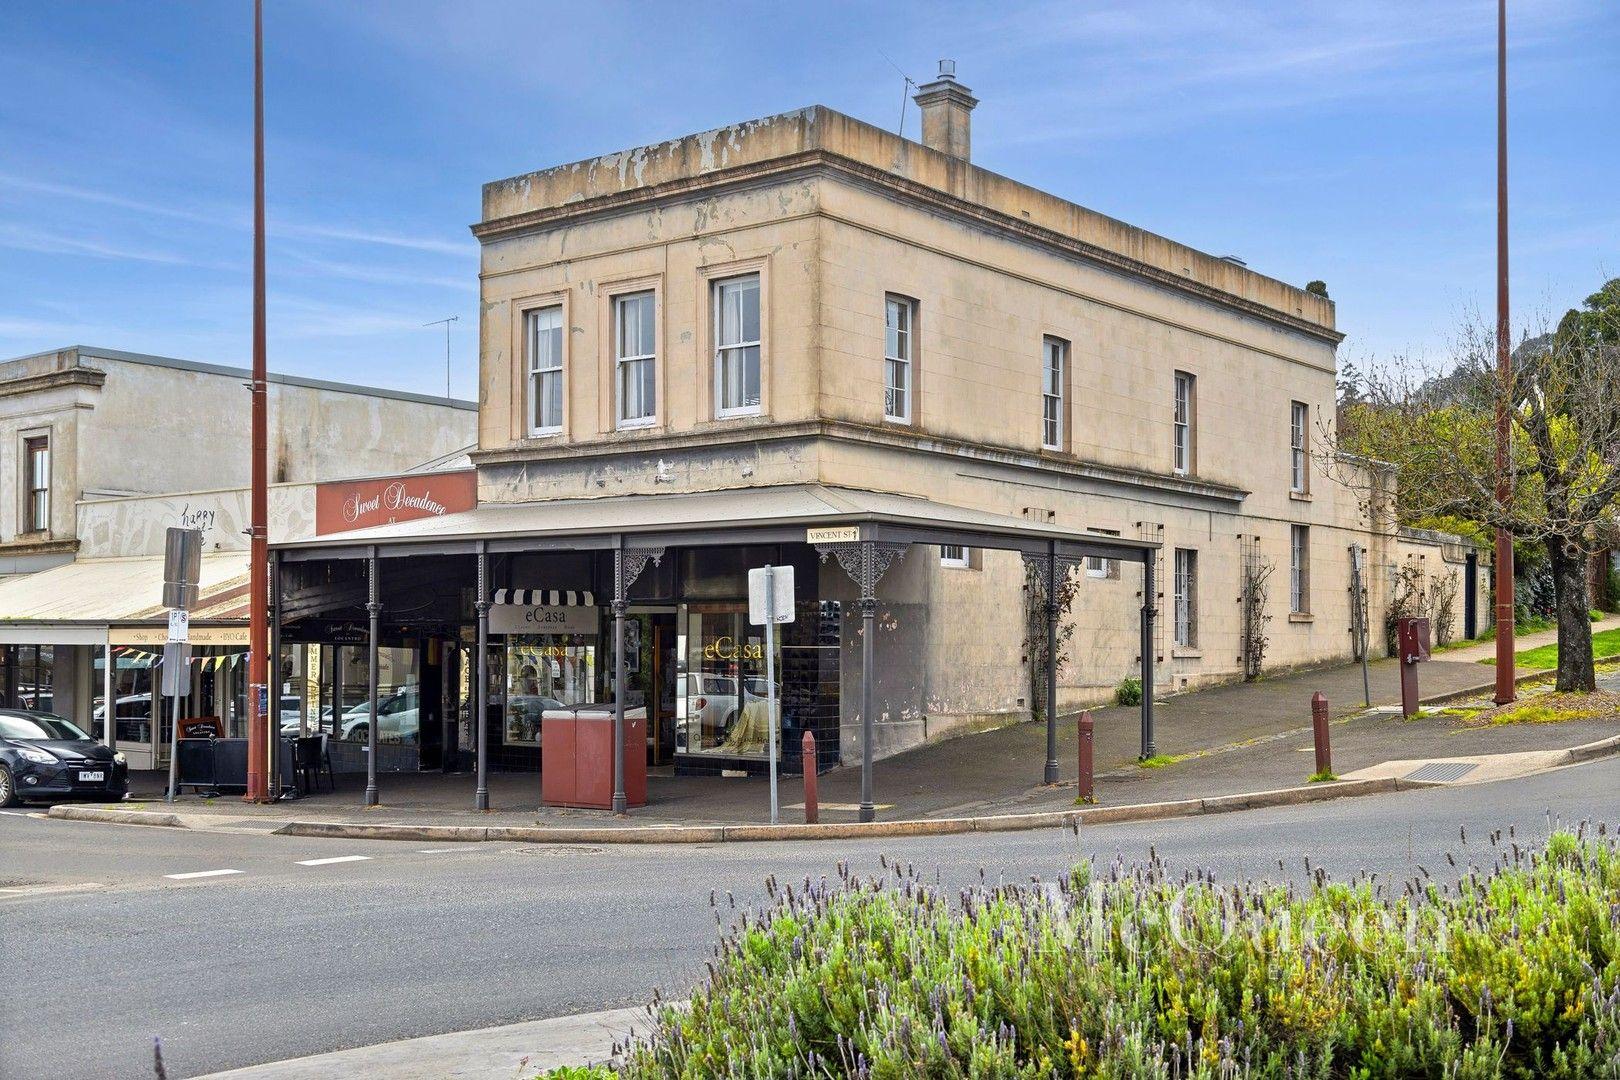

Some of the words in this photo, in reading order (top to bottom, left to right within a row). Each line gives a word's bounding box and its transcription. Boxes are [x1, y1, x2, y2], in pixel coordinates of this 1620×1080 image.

[343, 493, 380, 523] Sweet
[384, 482, 446, 516] Decadence
[182, 503, 215, 526] happy
[810, 531, 842, 540] VINCENT
[525, 606, 567, 623] eCasa
[187, 631, 212, 640] andmade
[704, 636, 763, 659] eCasa
